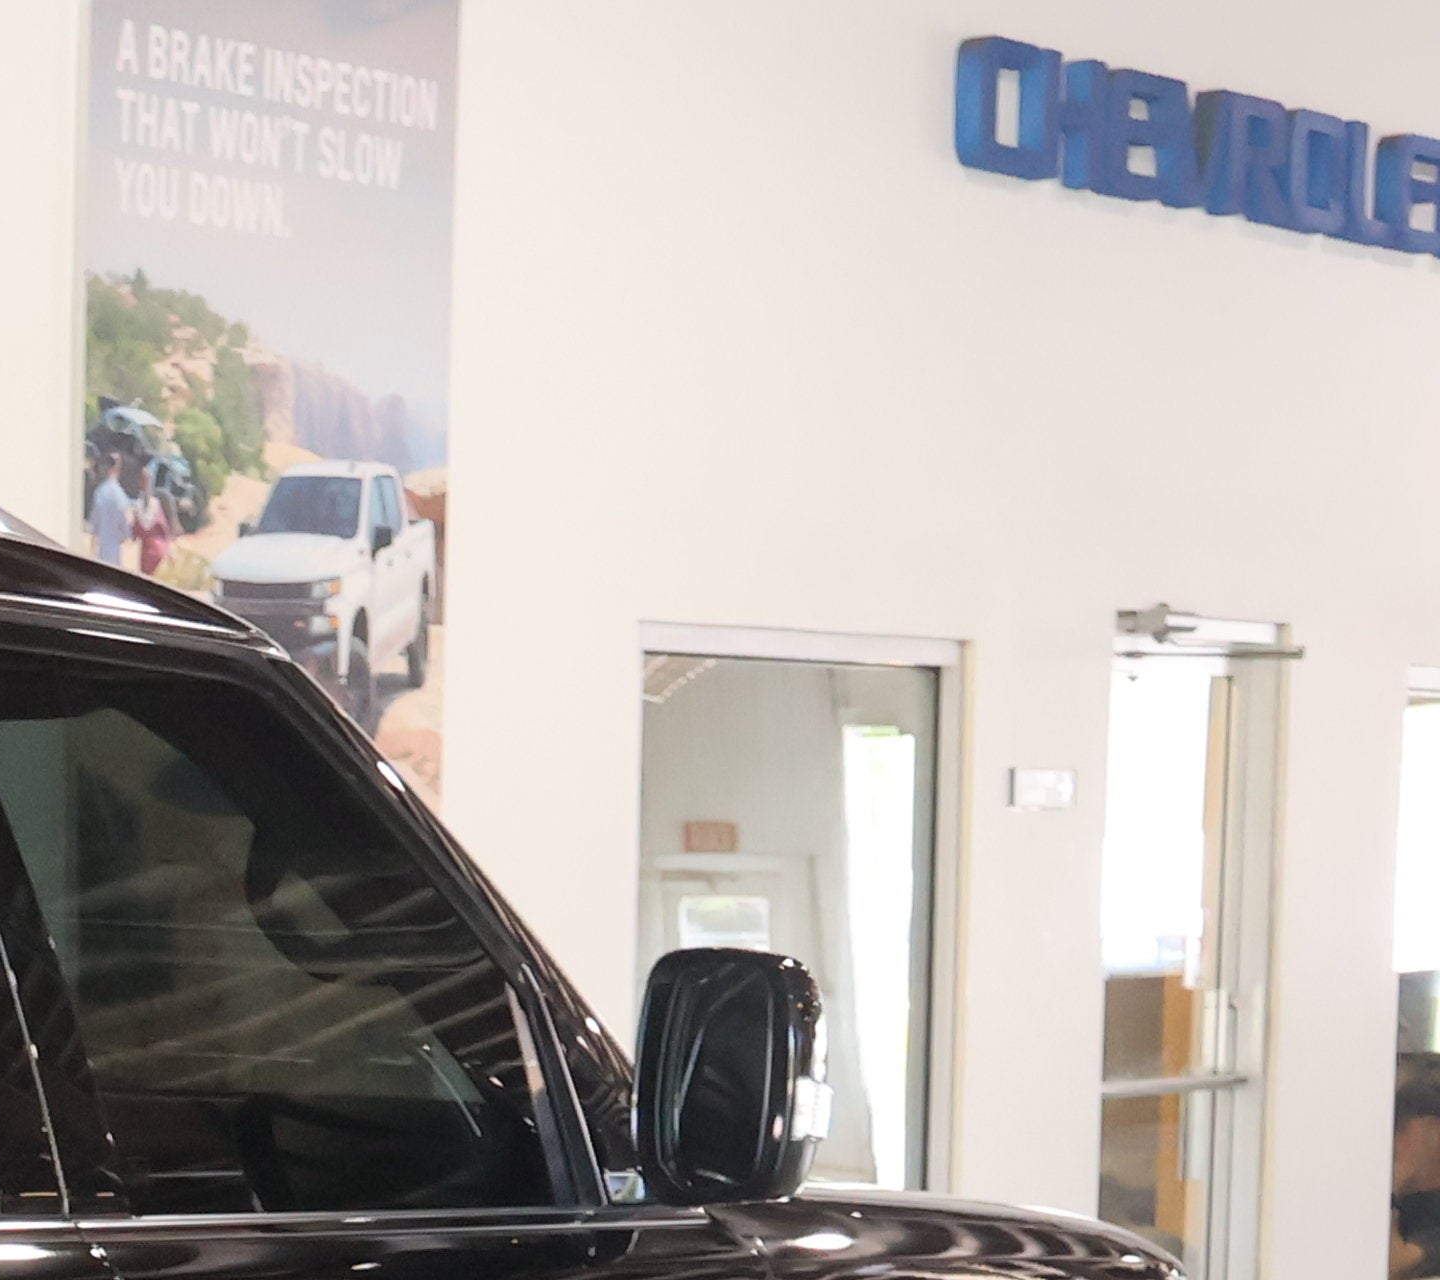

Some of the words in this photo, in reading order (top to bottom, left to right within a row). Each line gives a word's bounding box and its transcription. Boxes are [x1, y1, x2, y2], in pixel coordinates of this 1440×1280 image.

[116, 18, 140, 76] A
[147, 23, 258, 97] BRAKE
[263, 46, 439, 131] INSPECTION
[114, 88, 201, 154] THAT
[208, 106, 311, 175] WON'T
[316, 125, 405, 191] SLOW
[954, 36, 1440, 258] CHEVROLE
[114, 157, 180, 221] YOU
[188, 171, 293, 238] DOWN.
